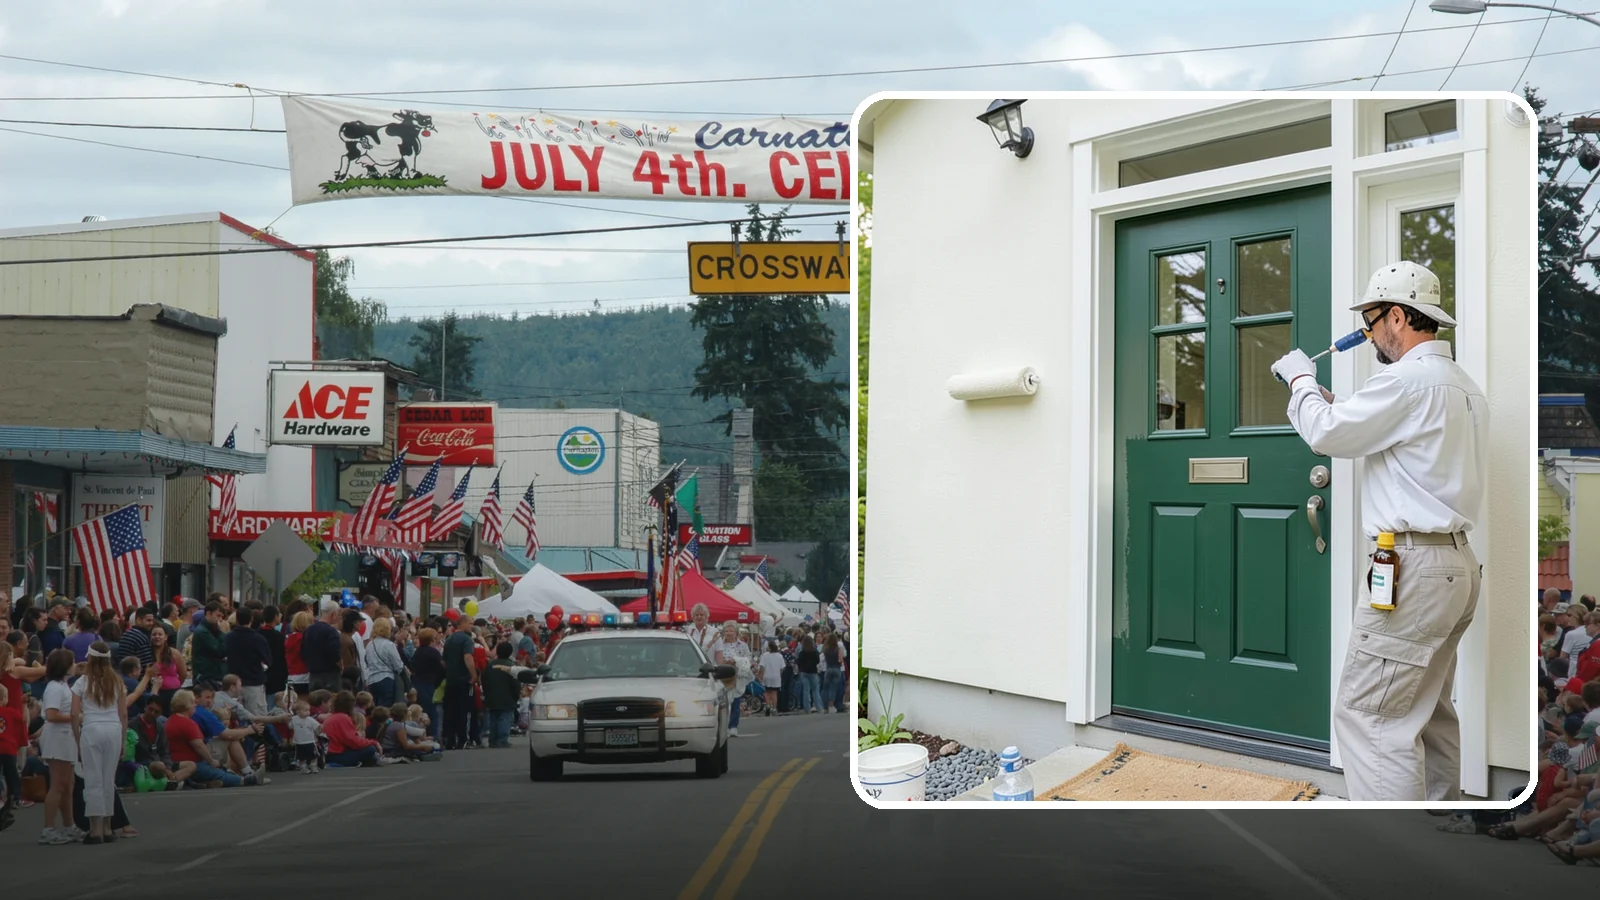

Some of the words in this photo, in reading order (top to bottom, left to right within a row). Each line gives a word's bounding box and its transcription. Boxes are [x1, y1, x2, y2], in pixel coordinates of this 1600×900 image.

[695, 121, 850, 149] Carnat
[481, 141, 605, 193] JULY
[632, 150, 746, 198] 4th.
[697, 254, 850, 280] CROSSWA
[283, 380, 373, 420] ACE
[406, 409, 452, 421] CEDAR
[283, 421, 370, 436] Hardware
[416, 428, 476, 447] Coca-Cola
[354, 467, 386, 479] Simpl
[96, 485, 124, 495] Vincent
[126, 486, 135, 495] de
[138, 486, 155, 495] Paul
[688, 526, 741, 535] CRNATION
[699, 535, 730, 543] GLASS
